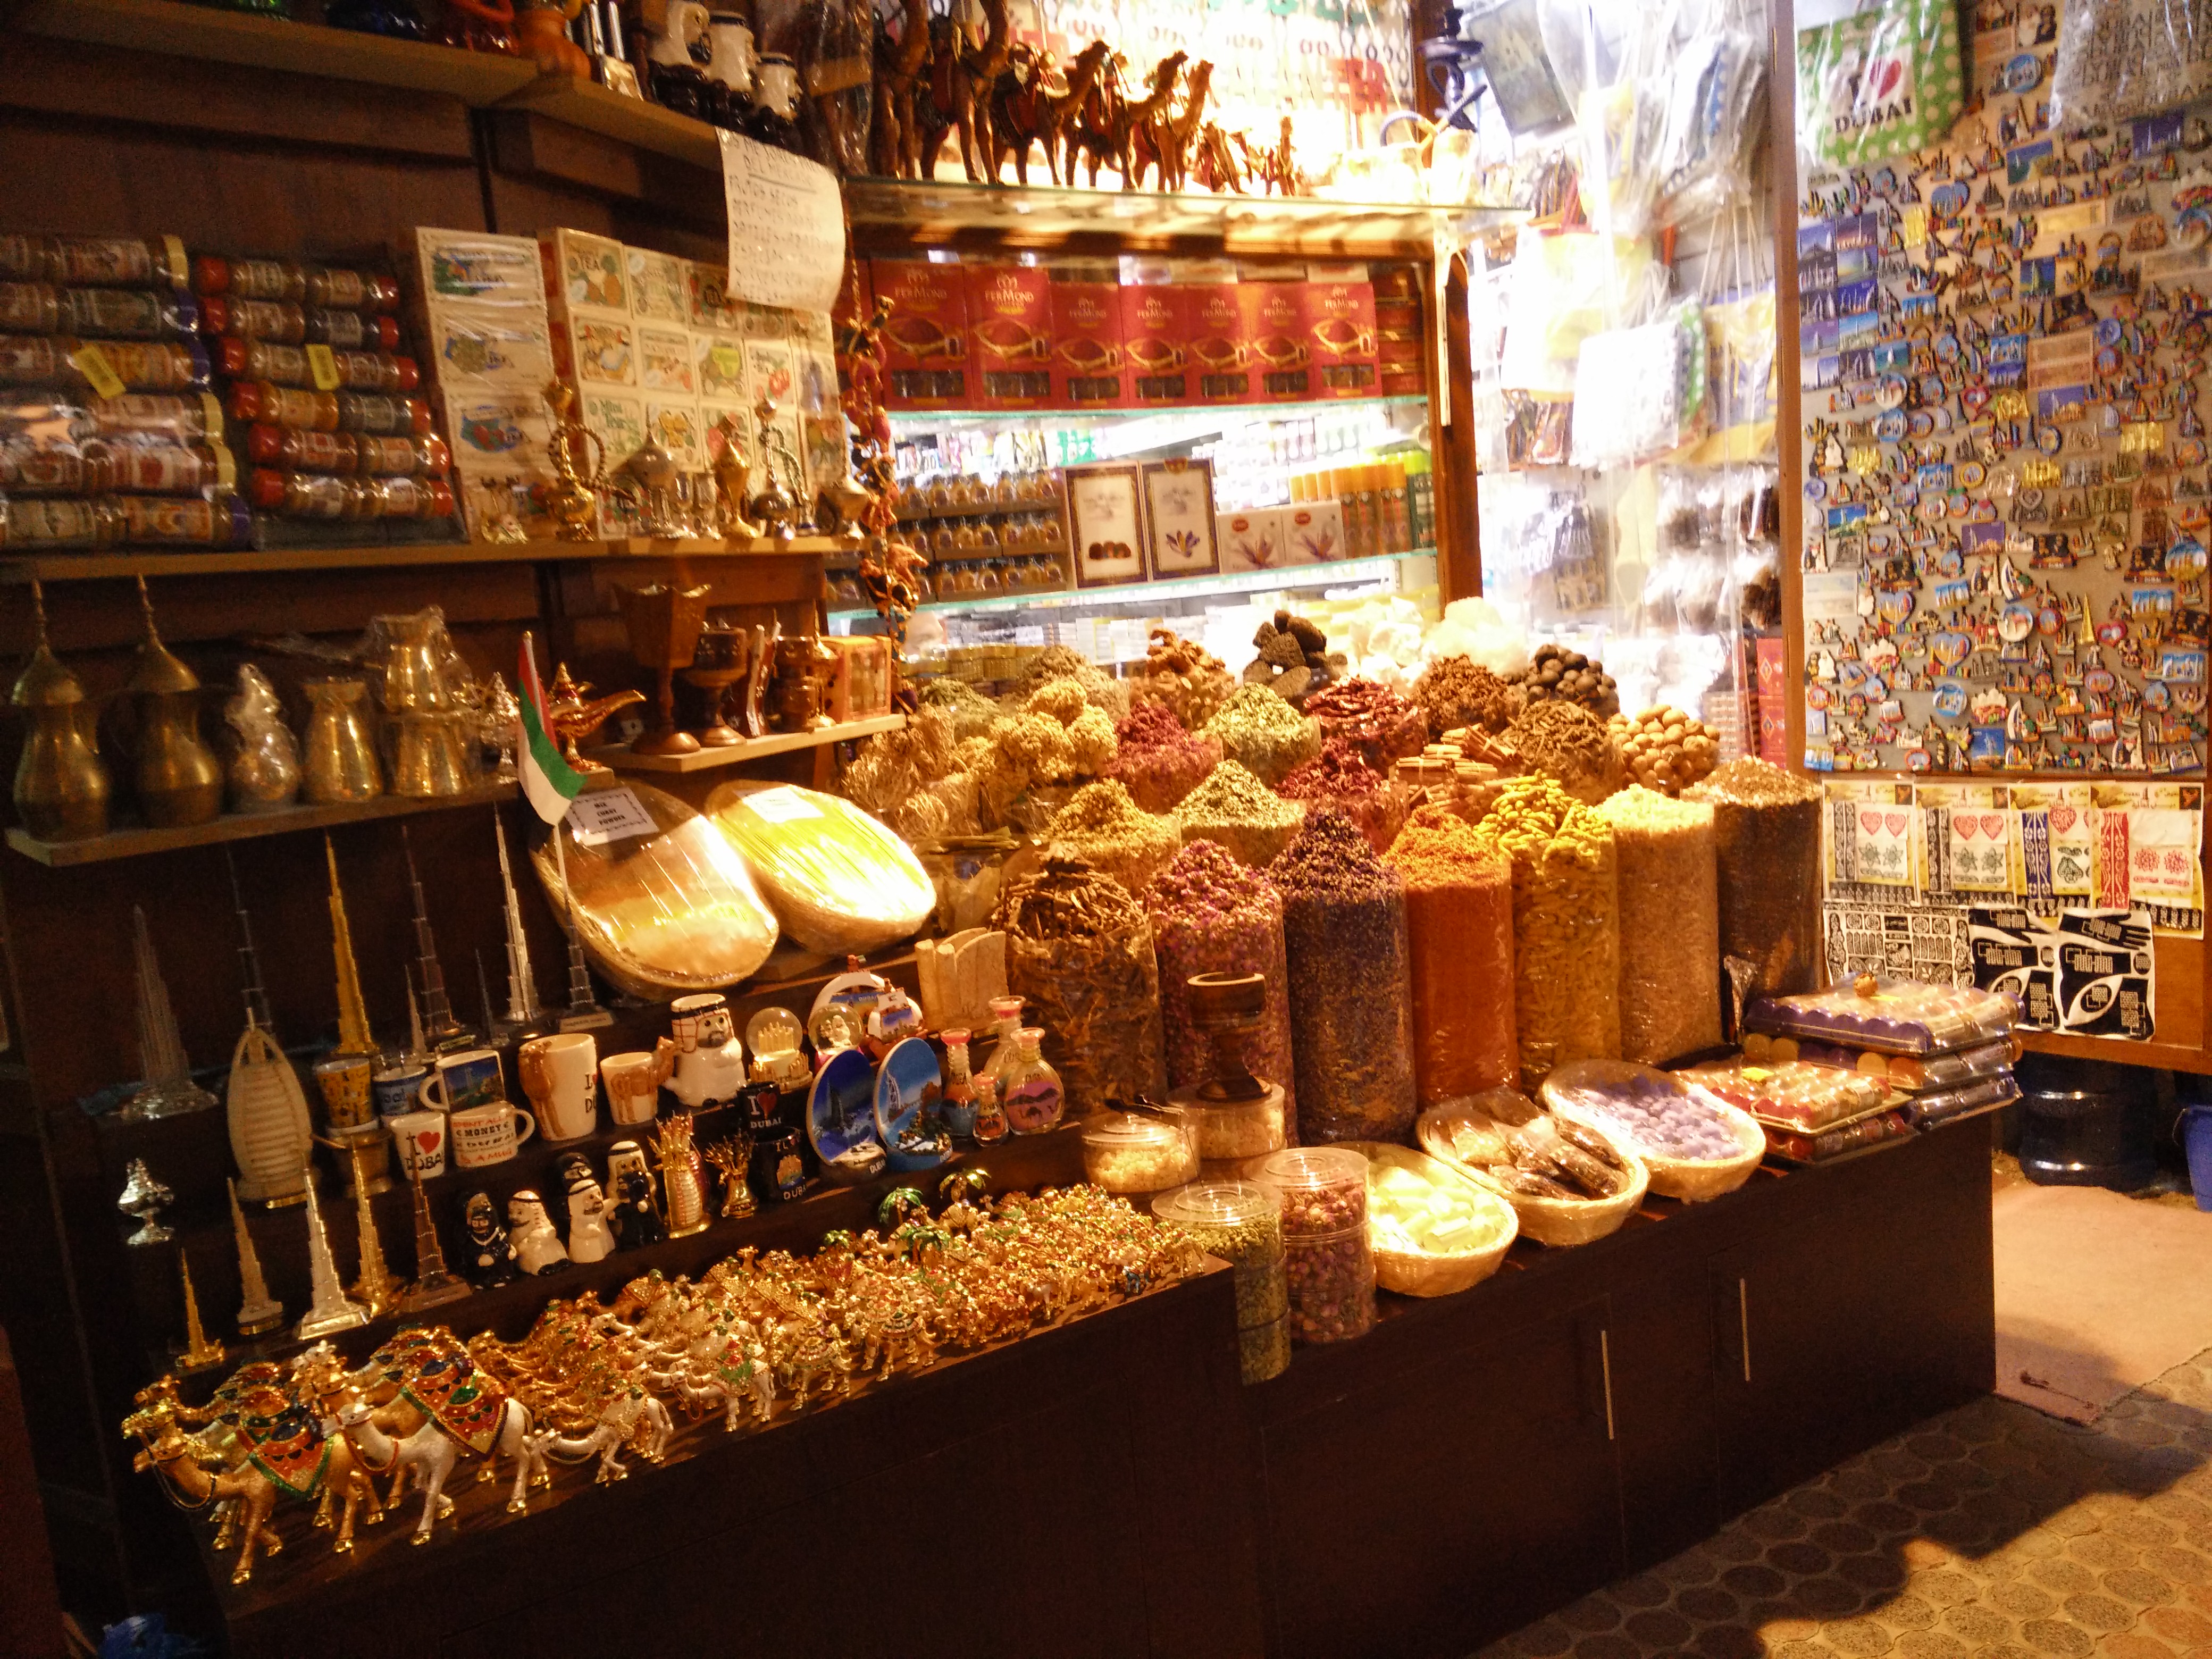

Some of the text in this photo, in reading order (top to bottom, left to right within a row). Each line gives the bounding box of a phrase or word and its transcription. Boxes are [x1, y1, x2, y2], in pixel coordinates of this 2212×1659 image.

[1834, 96, 1912, 133] DUBAI
[985, 289, 1034, 303] FERMOND
[748, 1095, 760, 1116] I
[750, 1117, 782, 1129] DUBAI
[465, 1124, 501, 1137] MONEY
